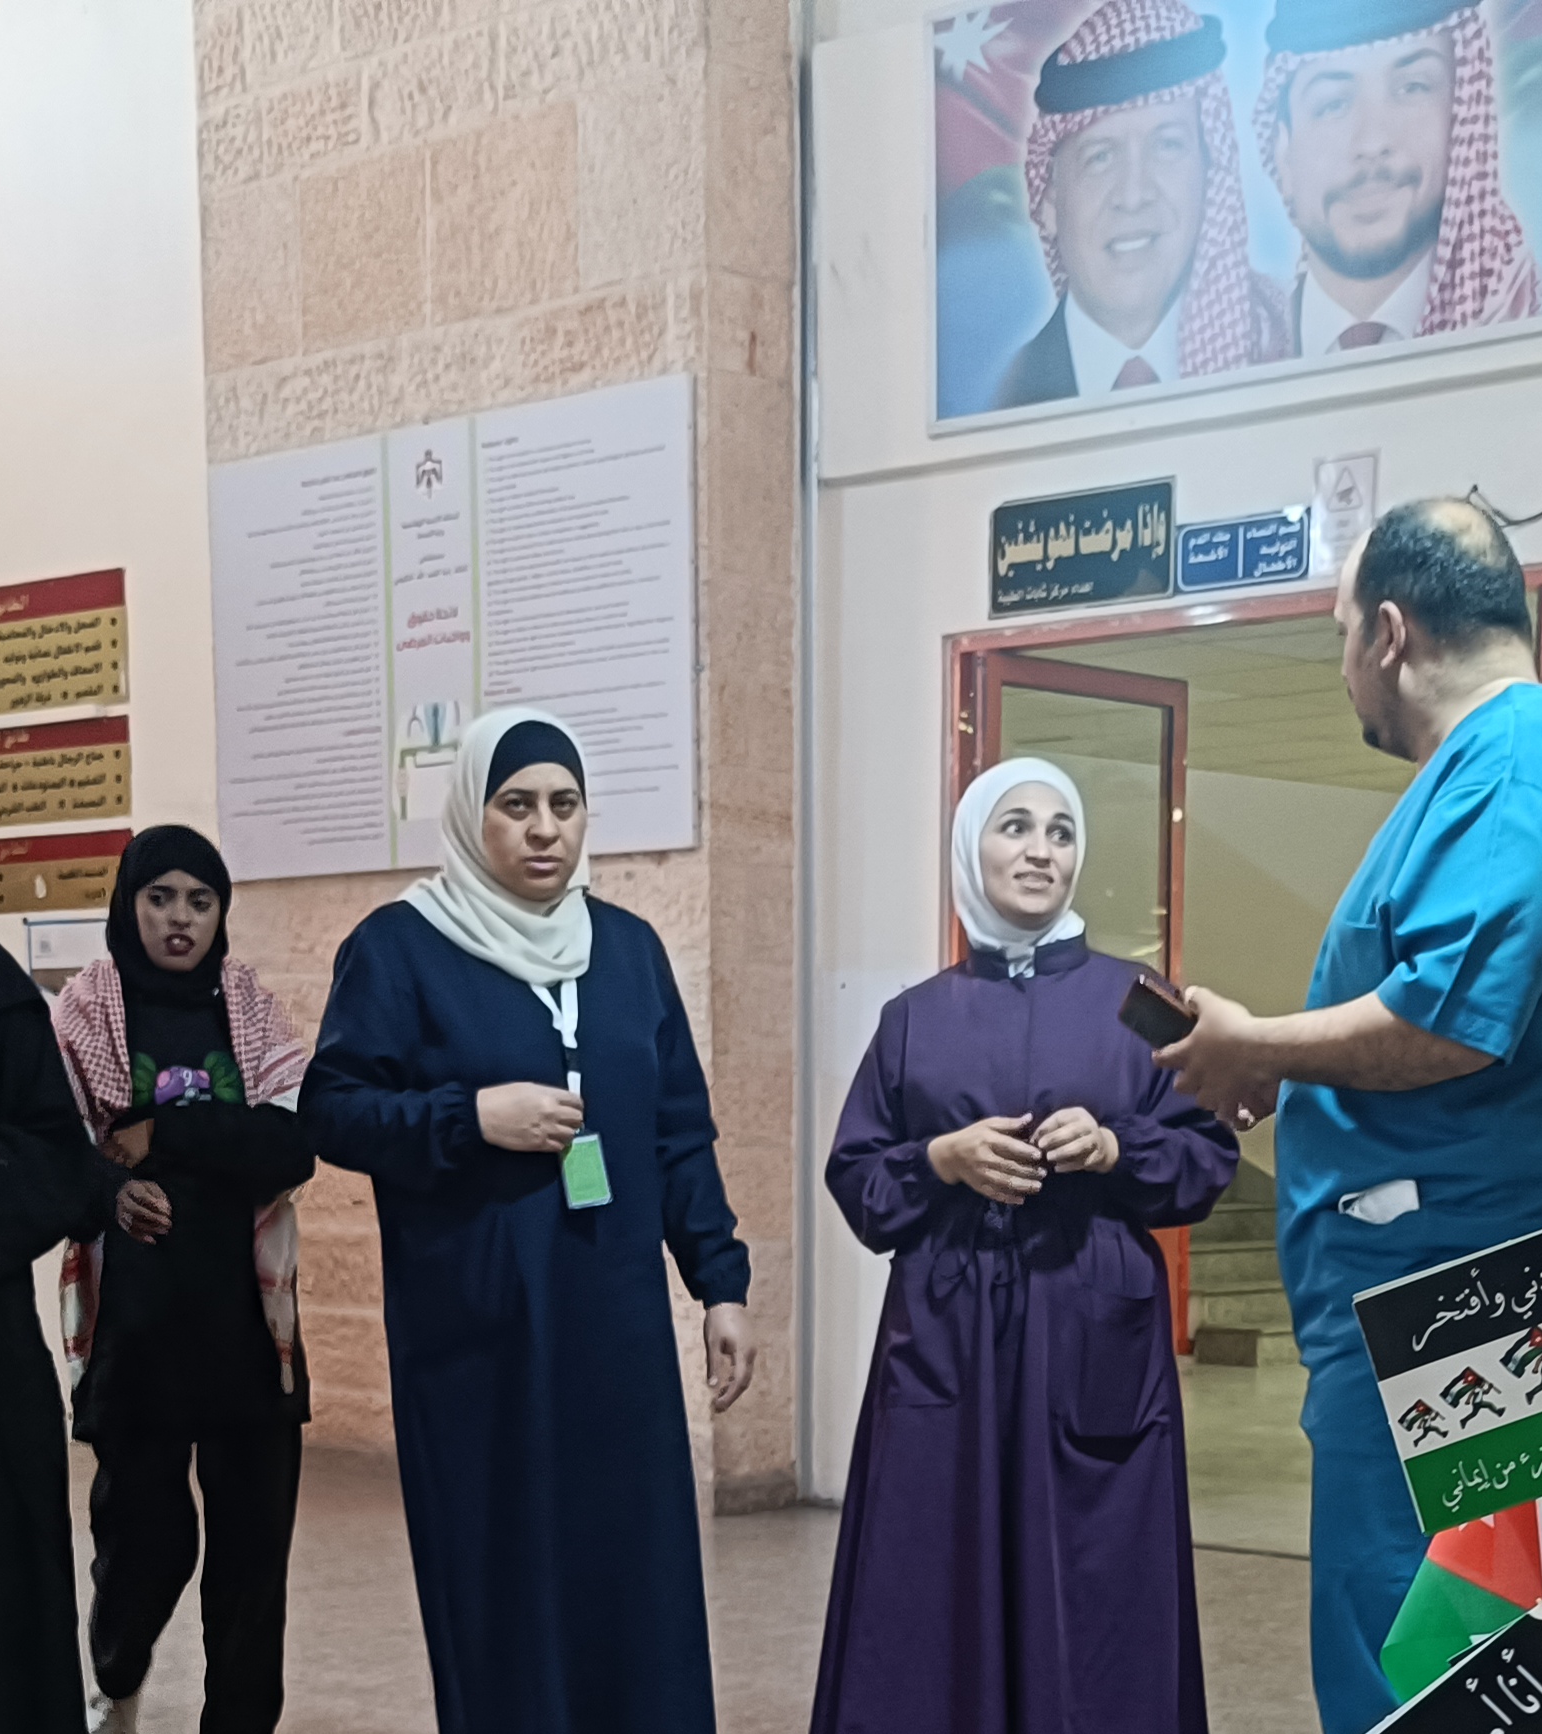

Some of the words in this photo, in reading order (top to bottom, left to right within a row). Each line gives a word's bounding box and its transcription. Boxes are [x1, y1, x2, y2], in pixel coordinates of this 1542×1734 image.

[997, 519, 1045, 578] يشفين
[1045, 513, 1076, 570] فهو
[1079, 507, 1134, 562] مرضت
[1412, 1267, 1507, 1352] وأفتخر
[1492, 1460, 1517, 1490] من
